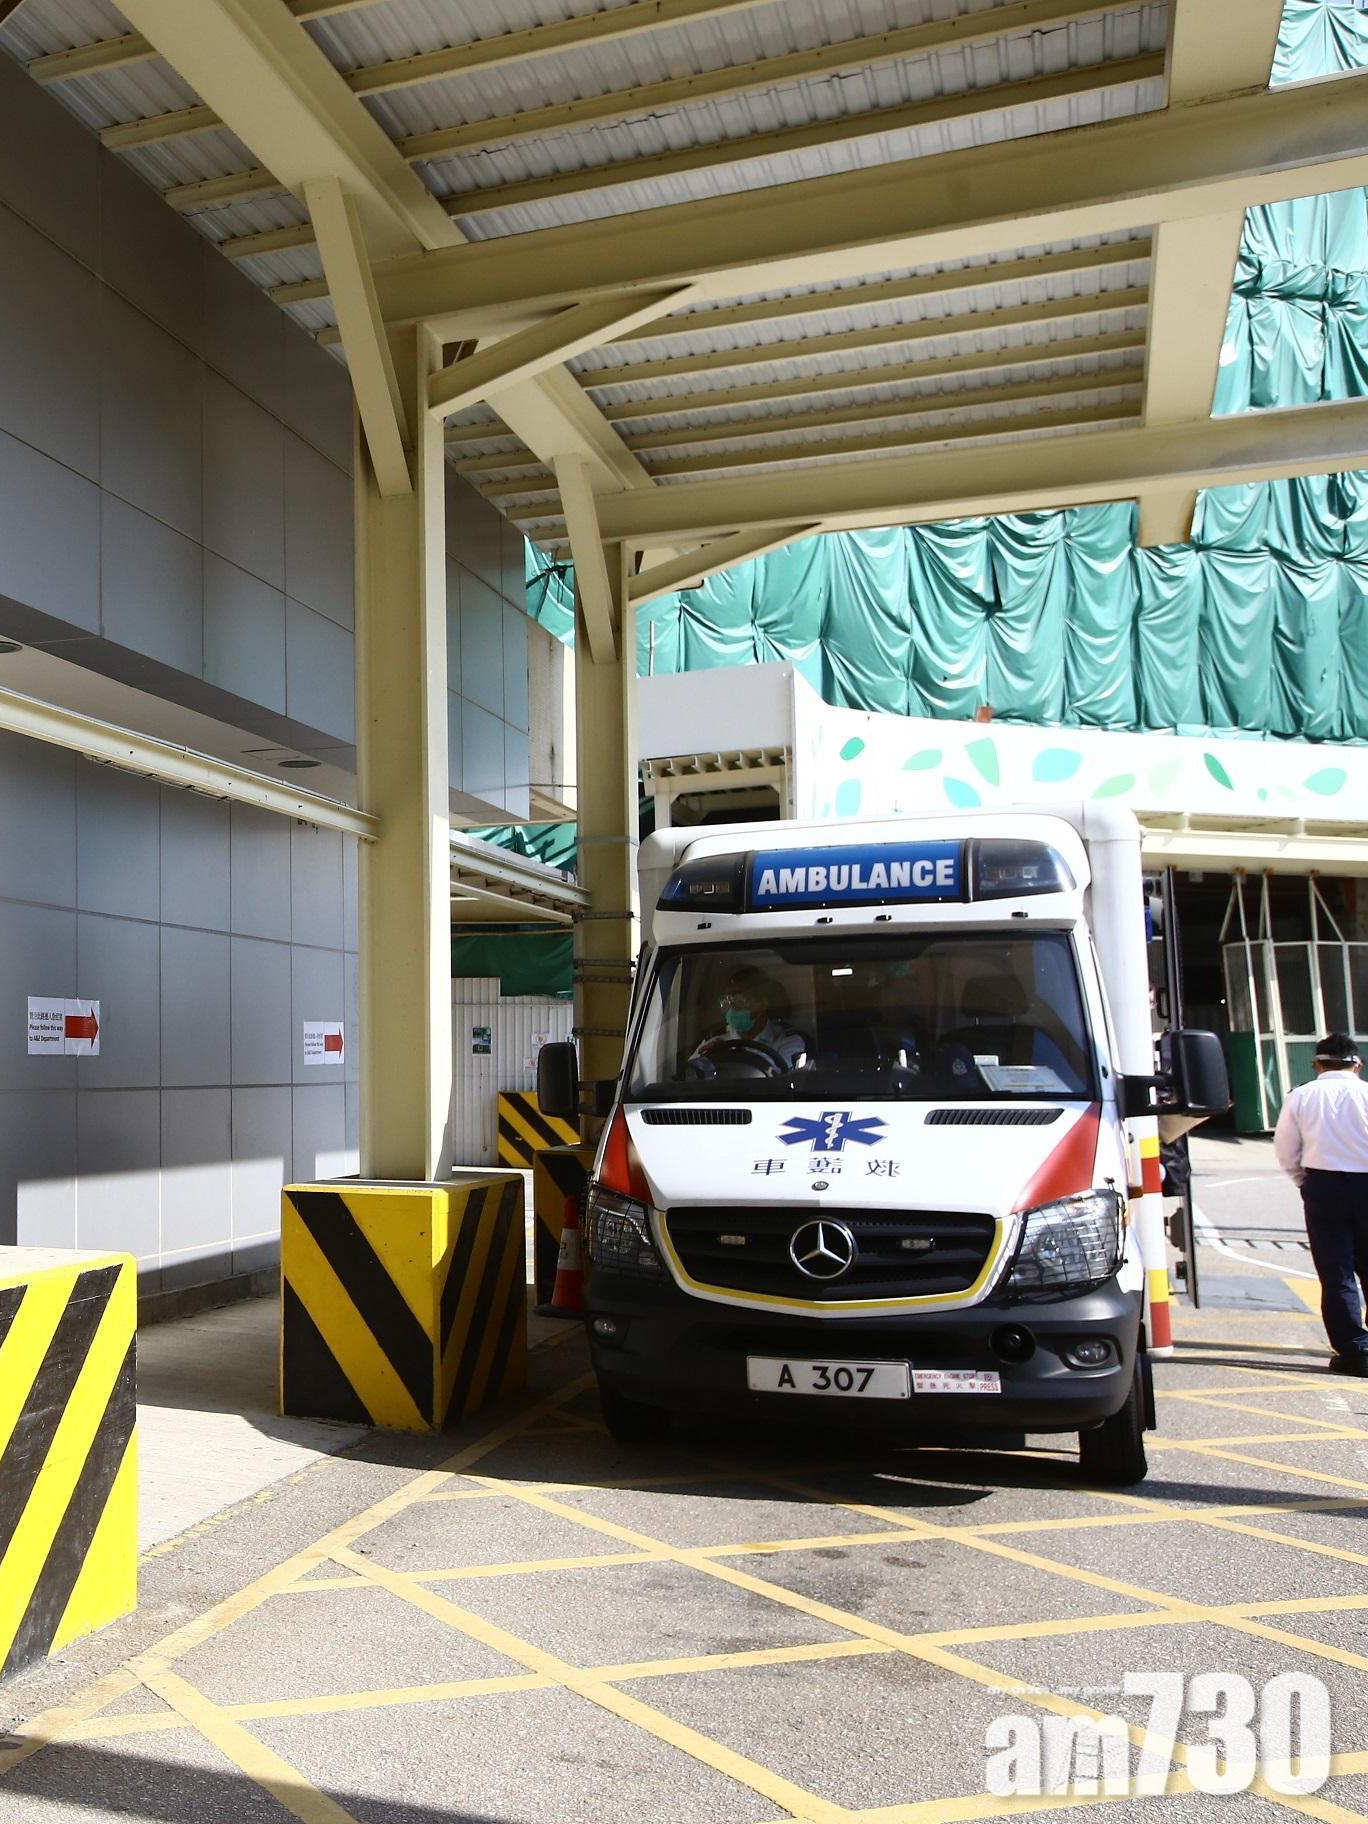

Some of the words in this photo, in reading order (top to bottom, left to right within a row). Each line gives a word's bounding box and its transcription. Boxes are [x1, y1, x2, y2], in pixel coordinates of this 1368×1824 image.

[757, 858, 955, 897] AMBULANCE
[777, 1363, 797, 1389] A
[811, 1365, 876, 1393] 307
[979, 1382, 999, 1392] PRESS
